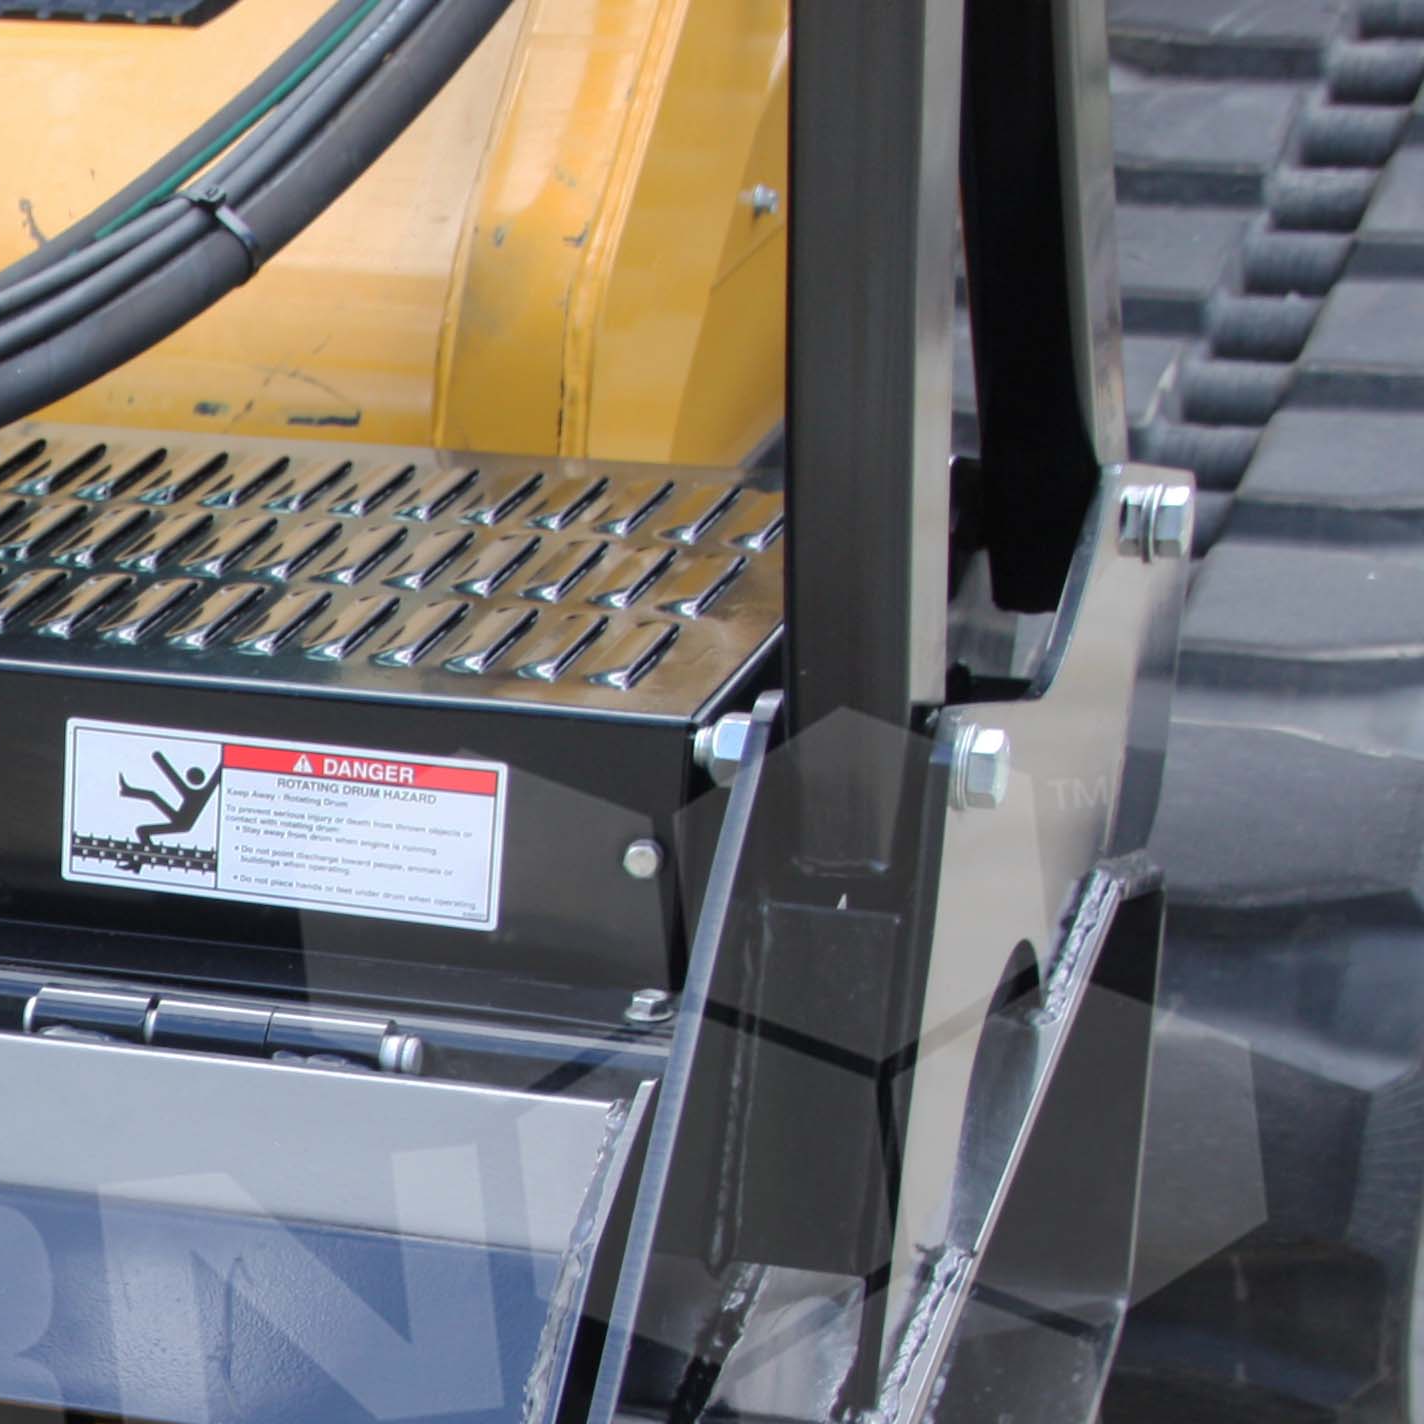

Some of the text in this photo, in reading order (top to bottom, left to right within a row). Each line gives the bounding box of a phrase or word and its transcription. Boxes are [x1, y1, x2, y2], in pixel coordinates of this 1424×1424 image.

[322, 758, 414, 784] DANGER
[276, 777, 437, 805] ROTATING DRUM HAZARD
